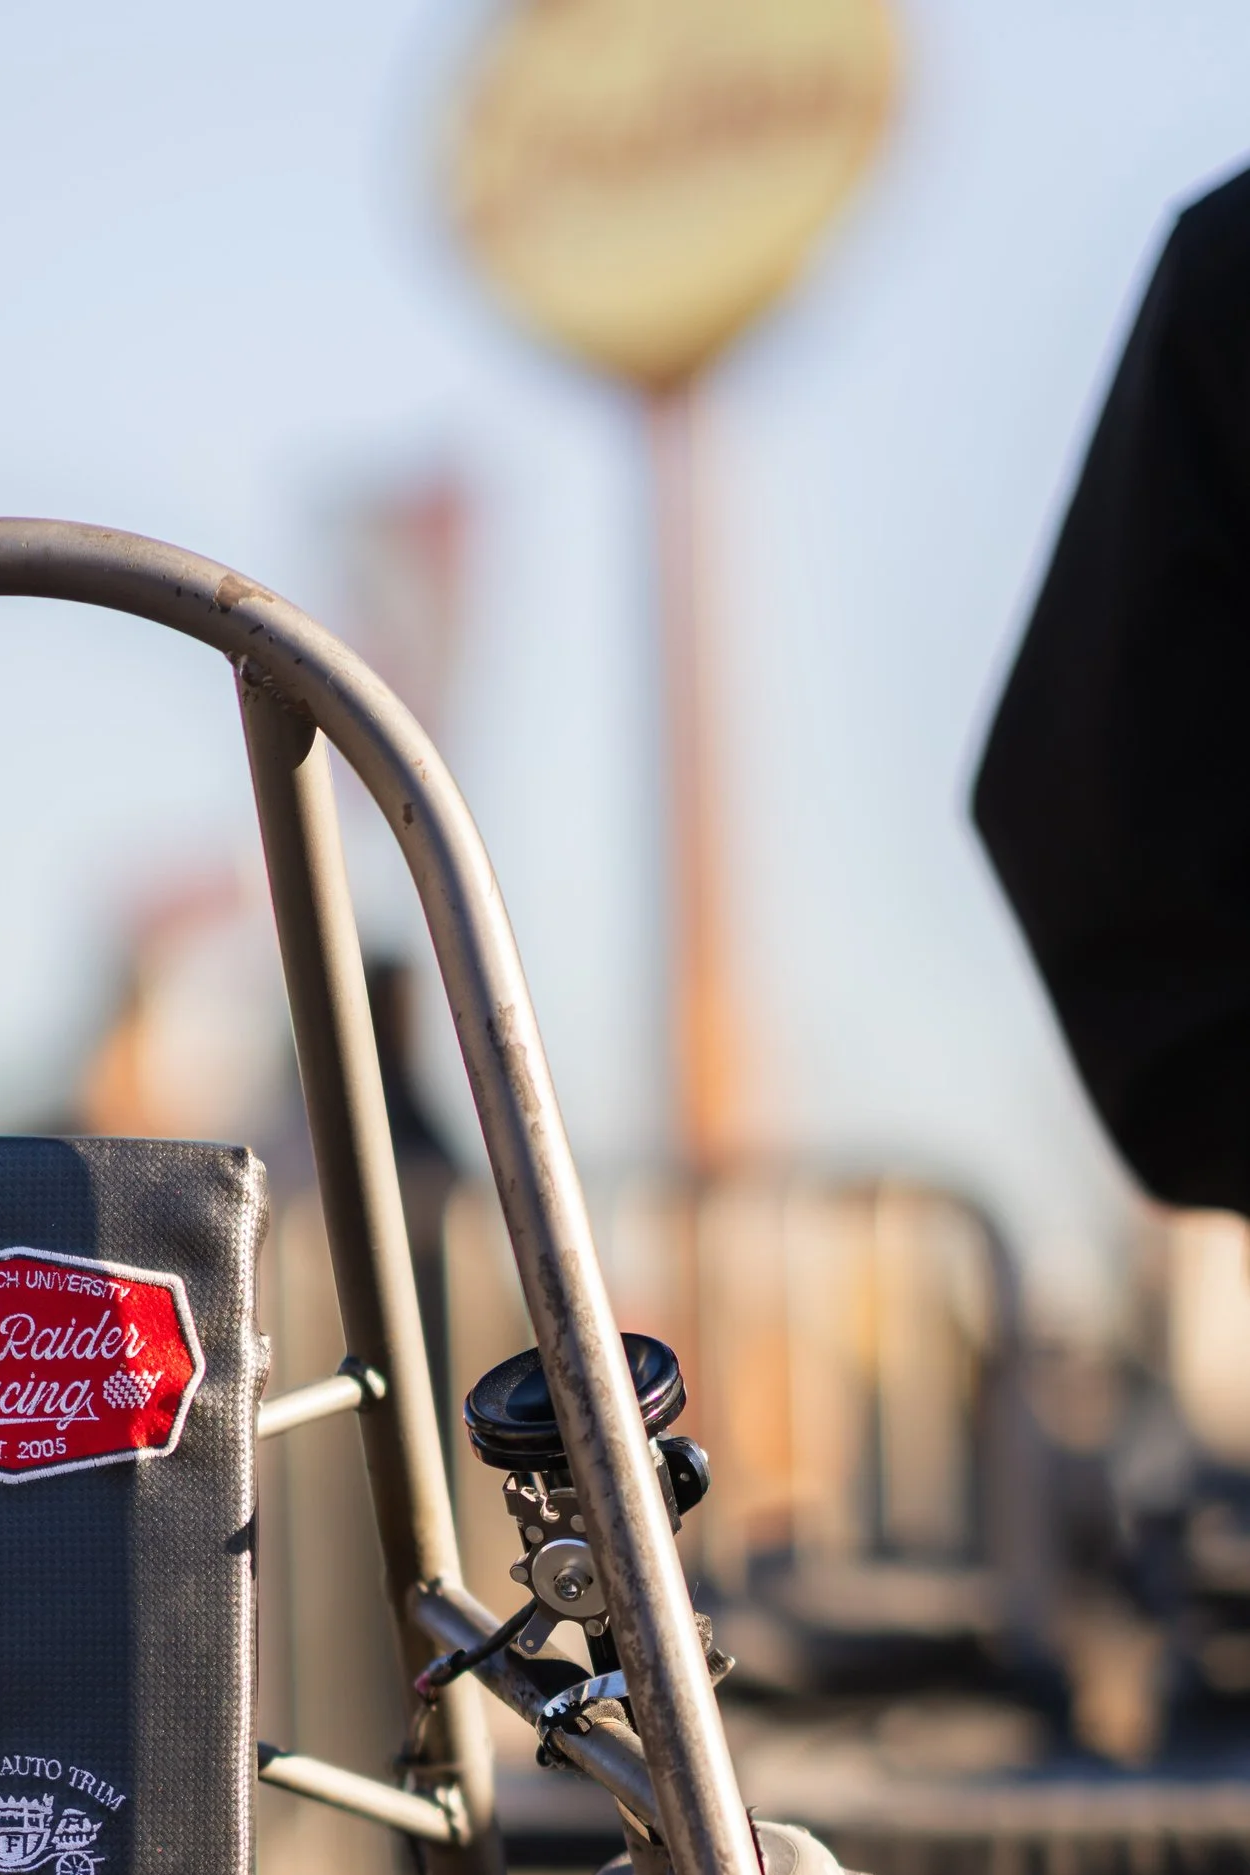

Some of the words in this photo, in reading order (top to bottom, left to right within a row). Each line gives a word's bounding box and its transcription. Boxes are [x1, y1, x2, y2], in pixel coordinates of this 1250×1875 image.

[25, 1270, 131, 1302] UNIVERSITY
[17, 1437, 67, 1460] 2005
[68, 1766, 127, 1812] TRIM
